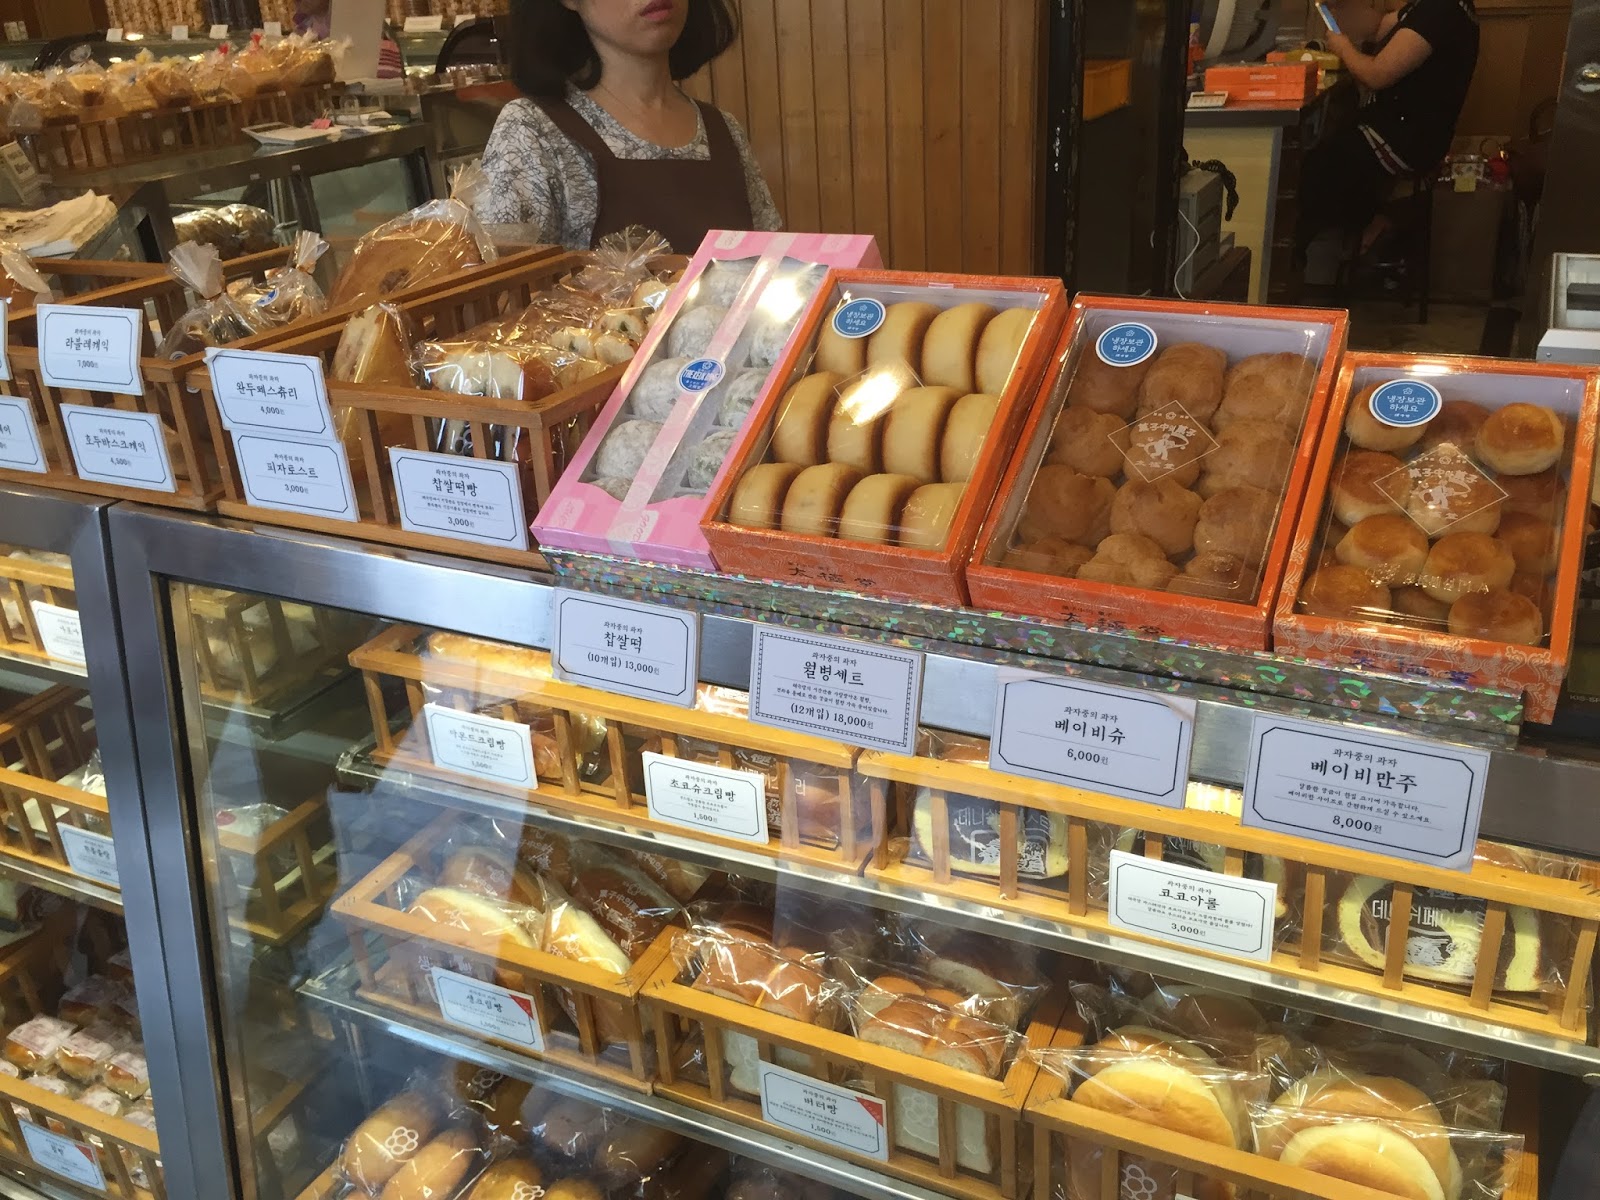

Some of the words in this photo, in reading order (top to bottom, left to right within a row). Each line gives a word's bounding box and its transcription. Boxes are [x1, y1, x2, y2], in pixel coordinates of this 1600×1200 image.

[845, 318, 867, 326] 하세요
[1112, 337, 1144, 346] 냉장보관
[1112, 345, 1136, 353] 하세요
[1387, 395, 1426, 406] 냉장보관
[1389, 404, 1419, 413] 하세요
[266, 461, 319, 478] 피자토스트
[284, 484, 309, 494] 3,000원
[432, 478, 478, 497] 찹쌀떡빵
[447, 516, 475, 528] 3,000원
[603, 621, 628, 632] 과자중의
[630, 626, 643, 635] 과자
[604, 632, 642, 654] 찹쌀떡
[587, 651, 622, 668] (10개입)
[625, 660, 660, 676] 13,000원
[812, 652, 840, 664] 과자중의
[842, 657, 858, 668] 과자
[803, 661, 864, 686] 월병세트
[790, 702, 830, 721] (12개입)
[833, 712, 874, 730] 18,000원
[1064, 706, 1098, 720] 과자중의
[1100, 713, 1118, 723] 과자
[1055, 719, 1126, 746] 베이비슈
[1067, 748, 1109, 766] 6,000원
[1333, 748, 1373, 764] 과자중의
[1377, 756, 1398, 767] 과자
[1310, 759, 1418, 794] 베이비만주
[670, 778, 736, 802] 초코슈크림빵
[1316, 796, 1343, 806] 사이즈로
[1346, 801, 1373, 812] 간편하게
[1375, 807, 1390, 816] 드실
[1332, 814, 1382, 835] 8,000원
[1158, 887, 1220, 911] 코코아롤
[1171, 922, 1206, 937] 3,000원
[804, 1097, 838, 1115] 버터빵
